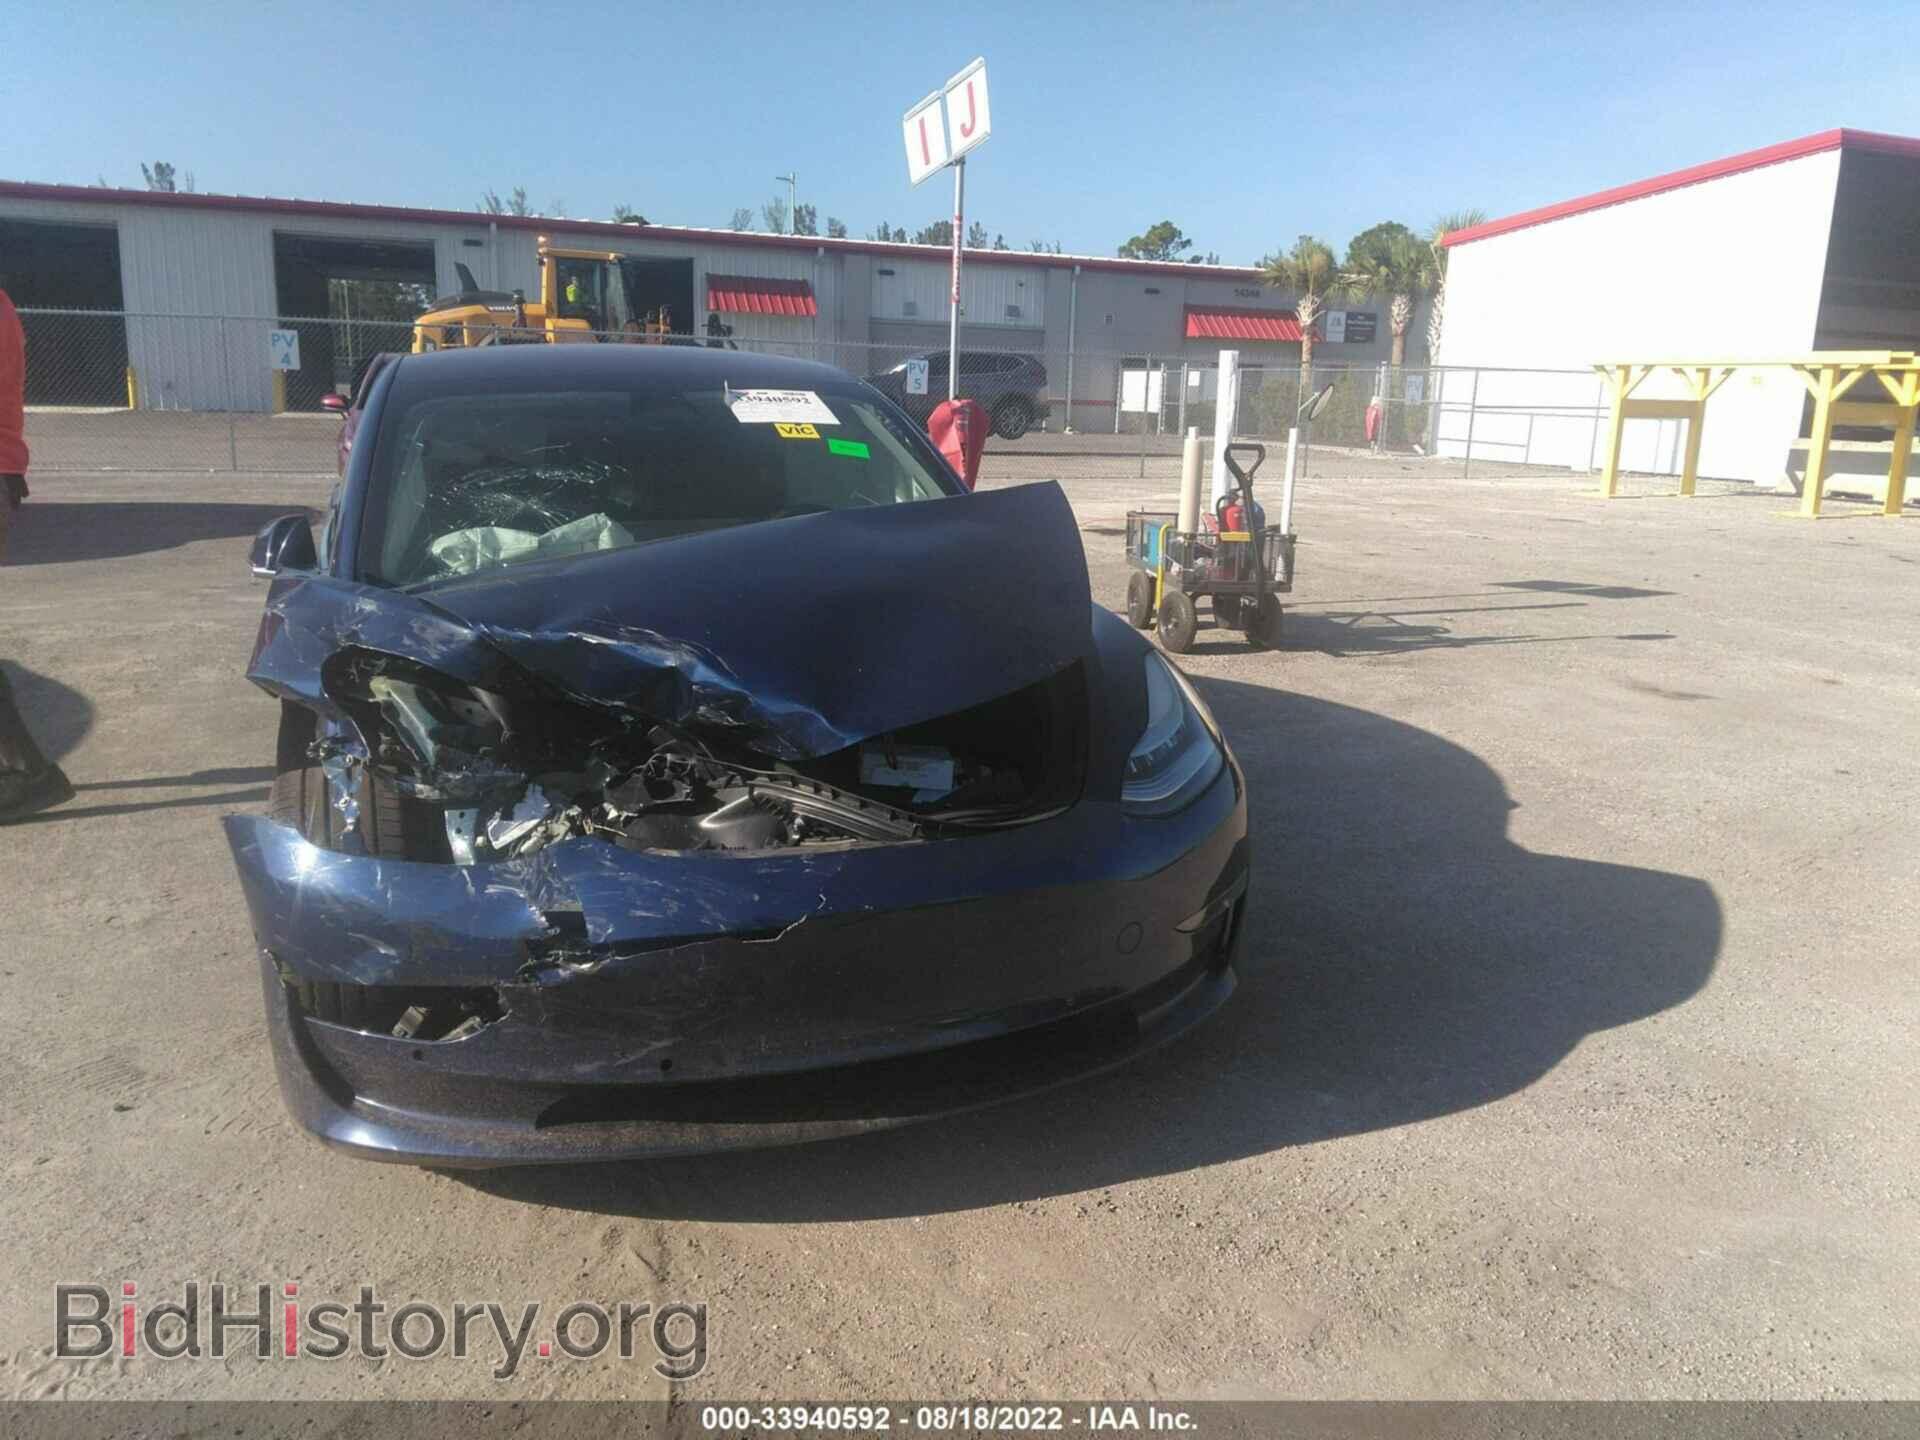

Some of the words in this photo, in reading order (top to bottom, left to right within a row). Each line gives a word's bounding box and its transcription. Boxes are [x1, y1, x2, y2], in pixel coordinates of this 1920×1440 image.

[960, 81, 976, 137] J
[919, 116, 929, 165] I
[271, 332, 296, 348] PV
[909, 362, 926, 375] PV
[914, 378, 922, 390] 5
[779, 425, 815, 435] VIC
